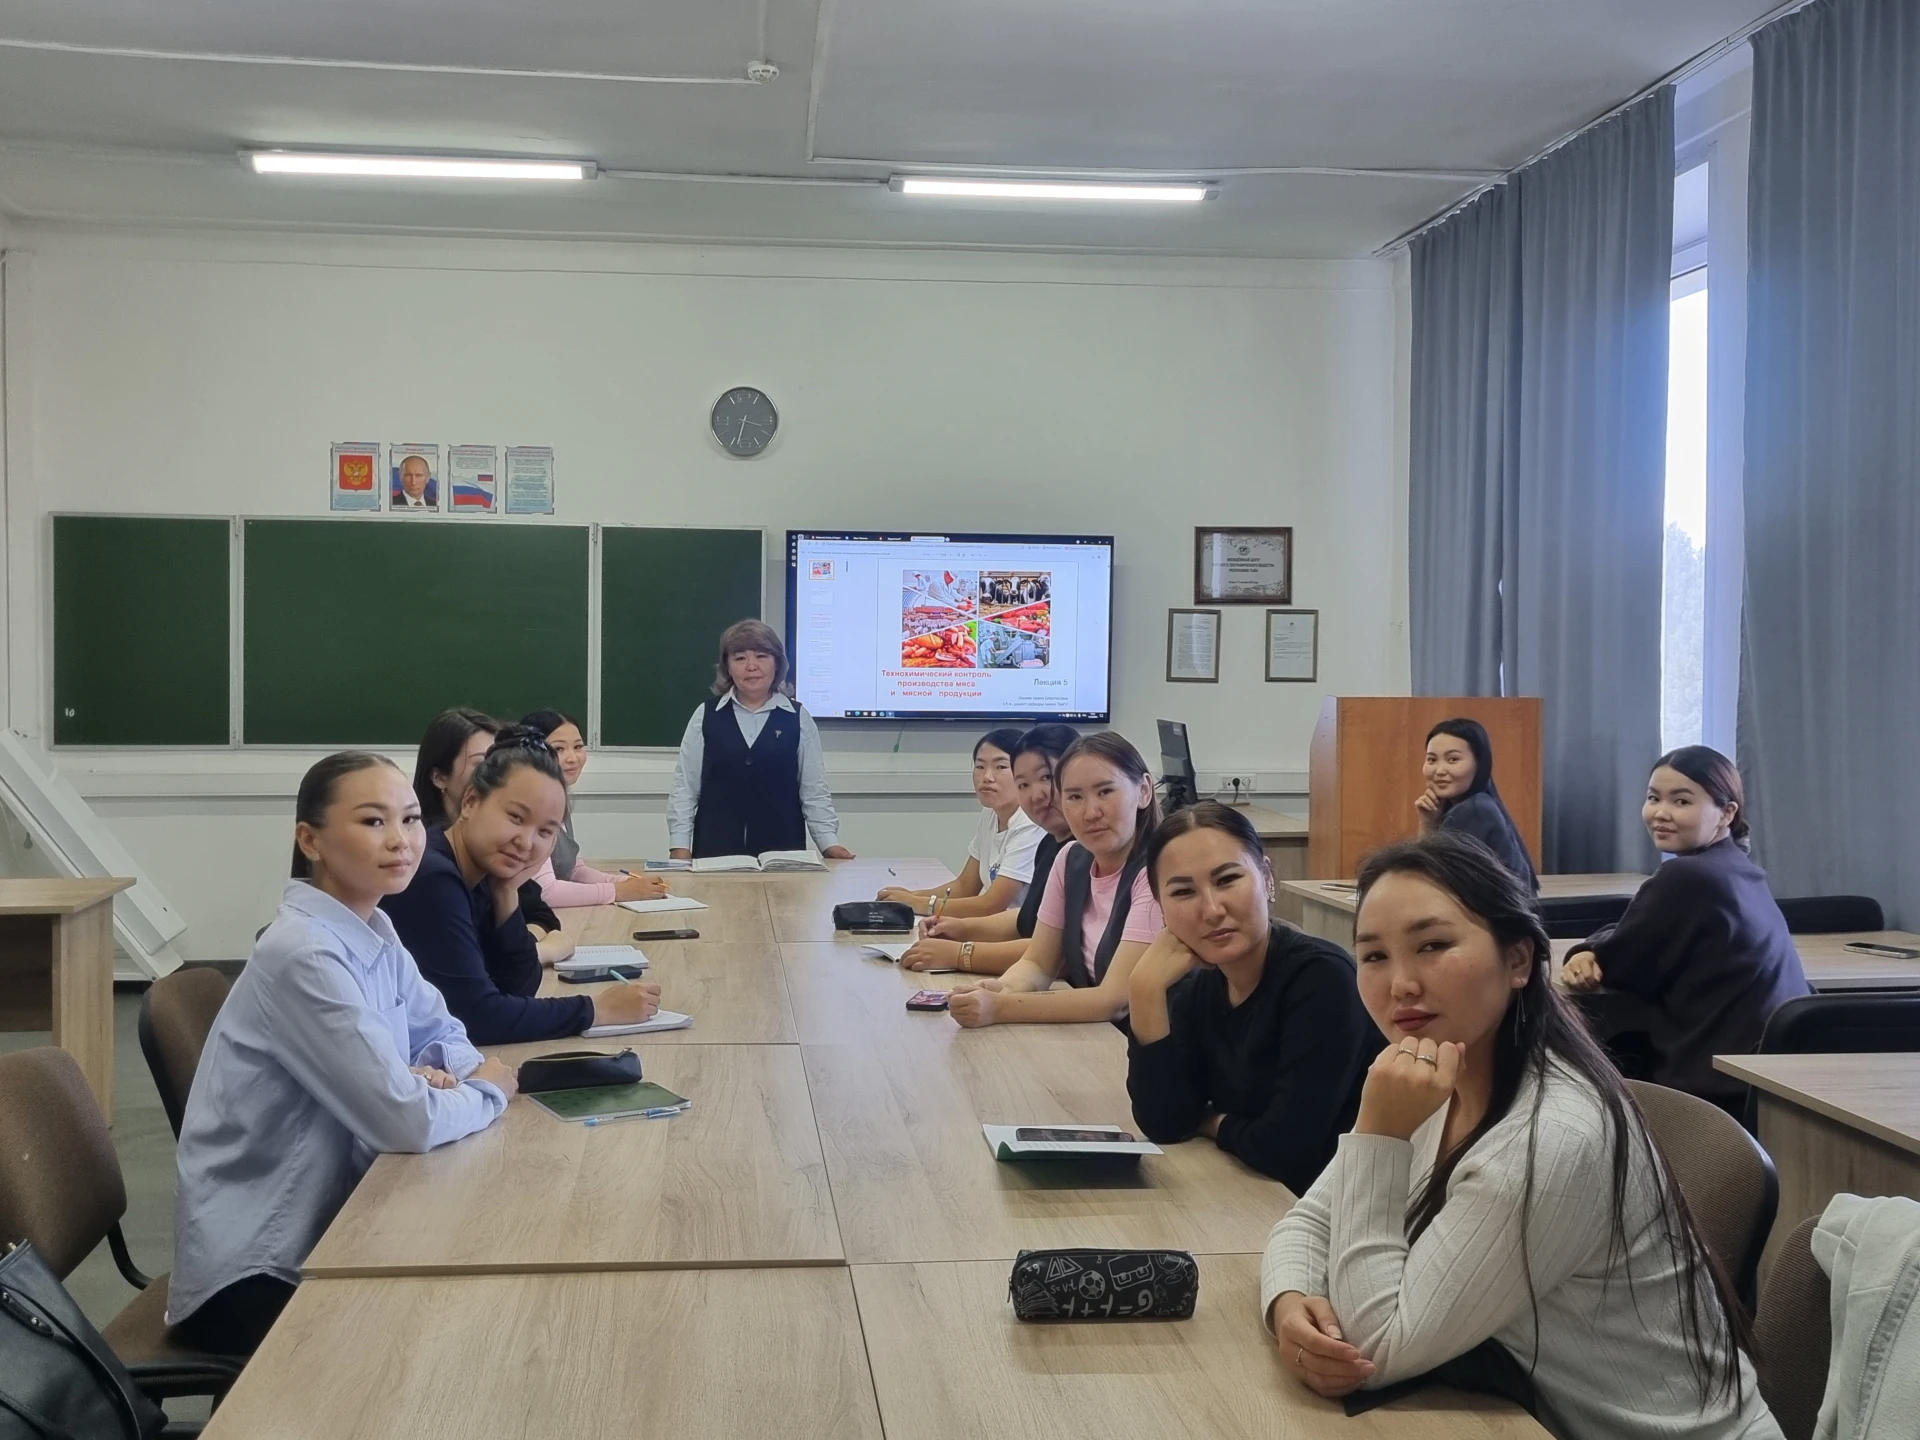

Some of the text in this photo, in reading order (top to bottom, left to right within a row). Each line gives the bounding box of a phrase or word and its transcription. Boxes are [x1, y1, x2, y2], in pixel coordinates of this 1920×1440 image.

[882, 670, 992, 679] Технохимический контроль
[1033, 678, 1068, 687] Лекция 5
[902, 689, 933, 697] мясной
[938, 690, 982, 698] продукции
